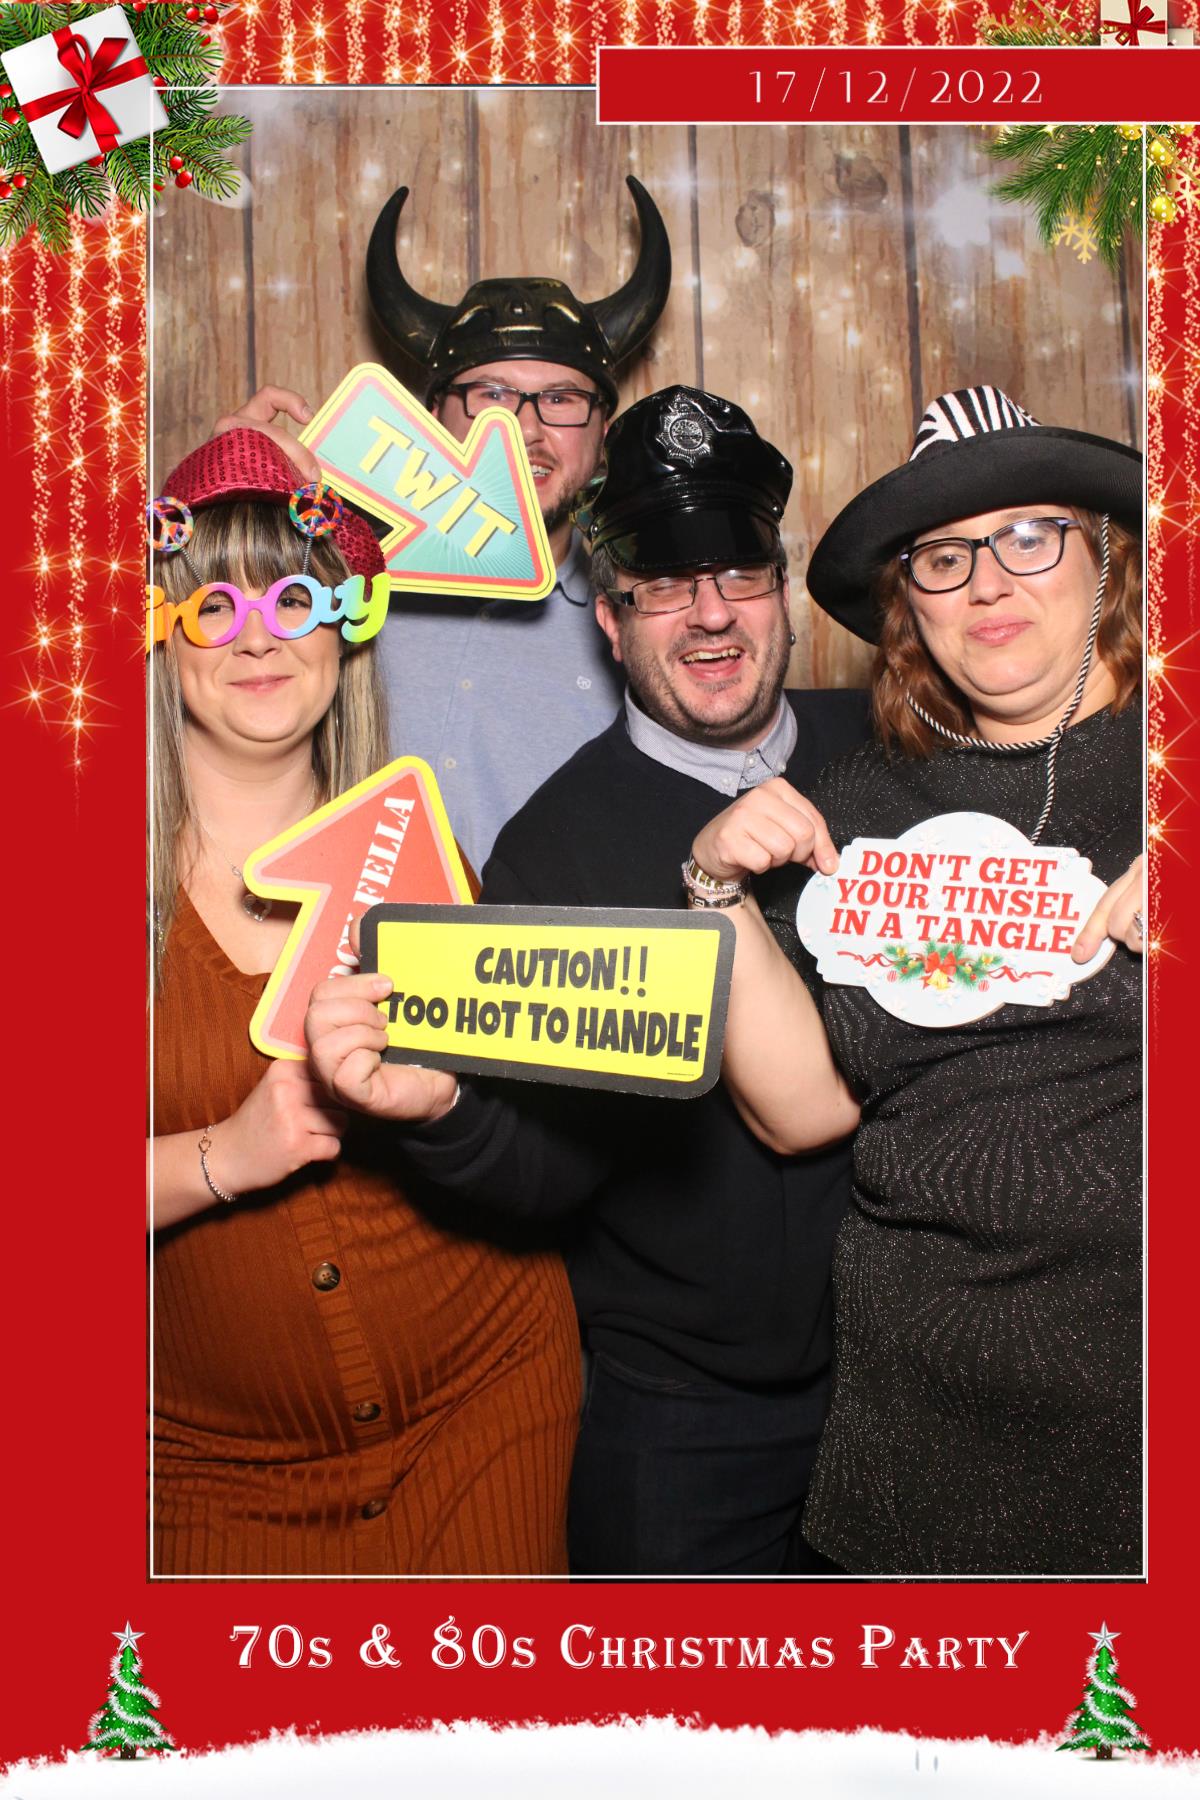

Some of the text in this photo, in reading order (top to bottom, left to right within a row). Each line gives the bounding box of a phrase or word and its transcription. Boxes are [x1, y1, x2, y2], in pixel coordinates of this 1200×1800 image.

[359, 416, 518, 557] TWIT
[353, 797, 415, 905] FELLA
[859, 851, 1058, 887] DON'T GET
[837, 878, 1080, 921] YOUR TINSEL
[829, 908, 1076, 954] IN A TANGLE
[475, 946, 648, 997] CAUTION!!
[386, 992, 703, 1062] TOO HOT TO HANDLE
